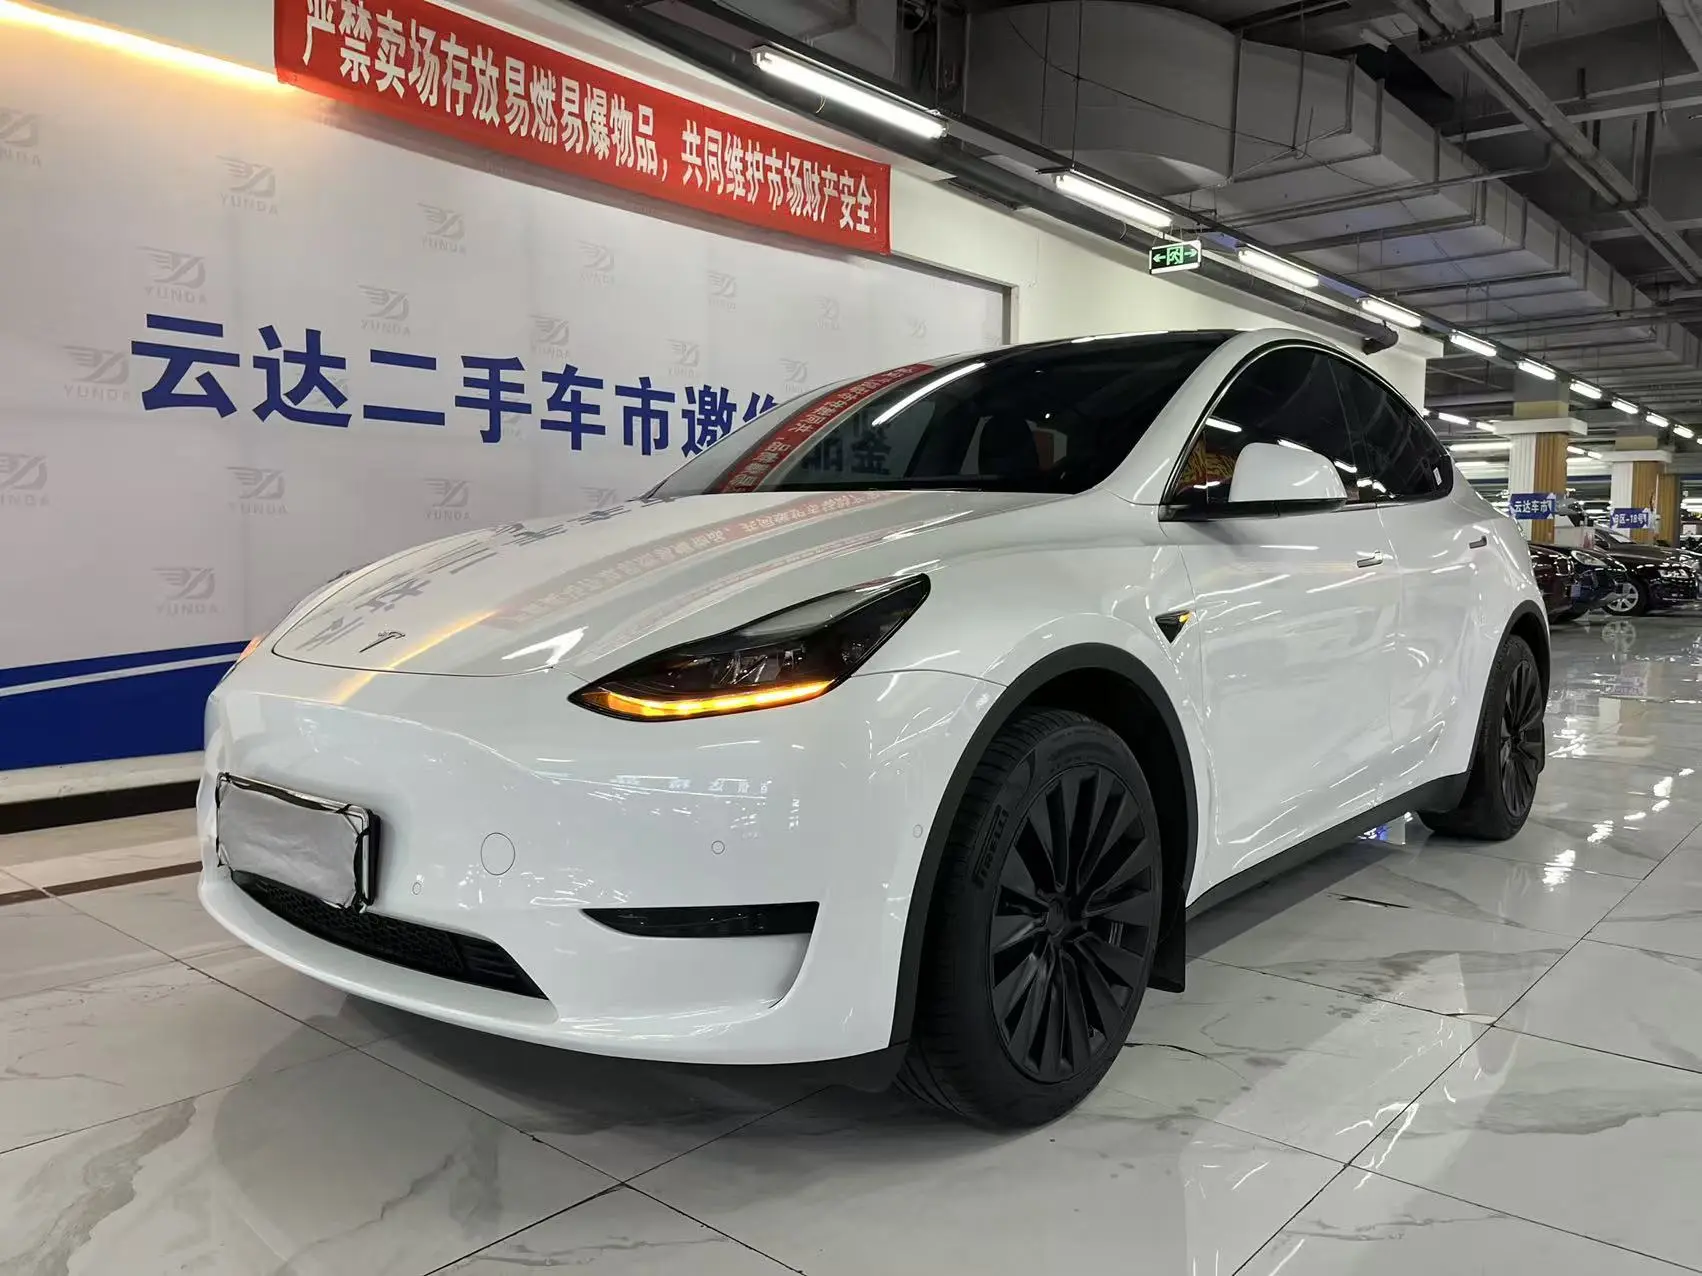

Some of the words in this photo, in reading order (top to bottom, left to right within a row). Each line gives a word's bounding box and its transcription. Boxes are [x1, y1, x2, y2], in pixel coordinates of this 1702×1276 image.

[221, 194, 278, 215] YUNDA
[144, 286, 208, 305] YUNDA
[361, 319, 412, 337] YUNDA
[228, 502, 289, 515] YUNDA
[425, 510, 470, 521] YUNDA
[157, 603, 220, 617] YUNDA
